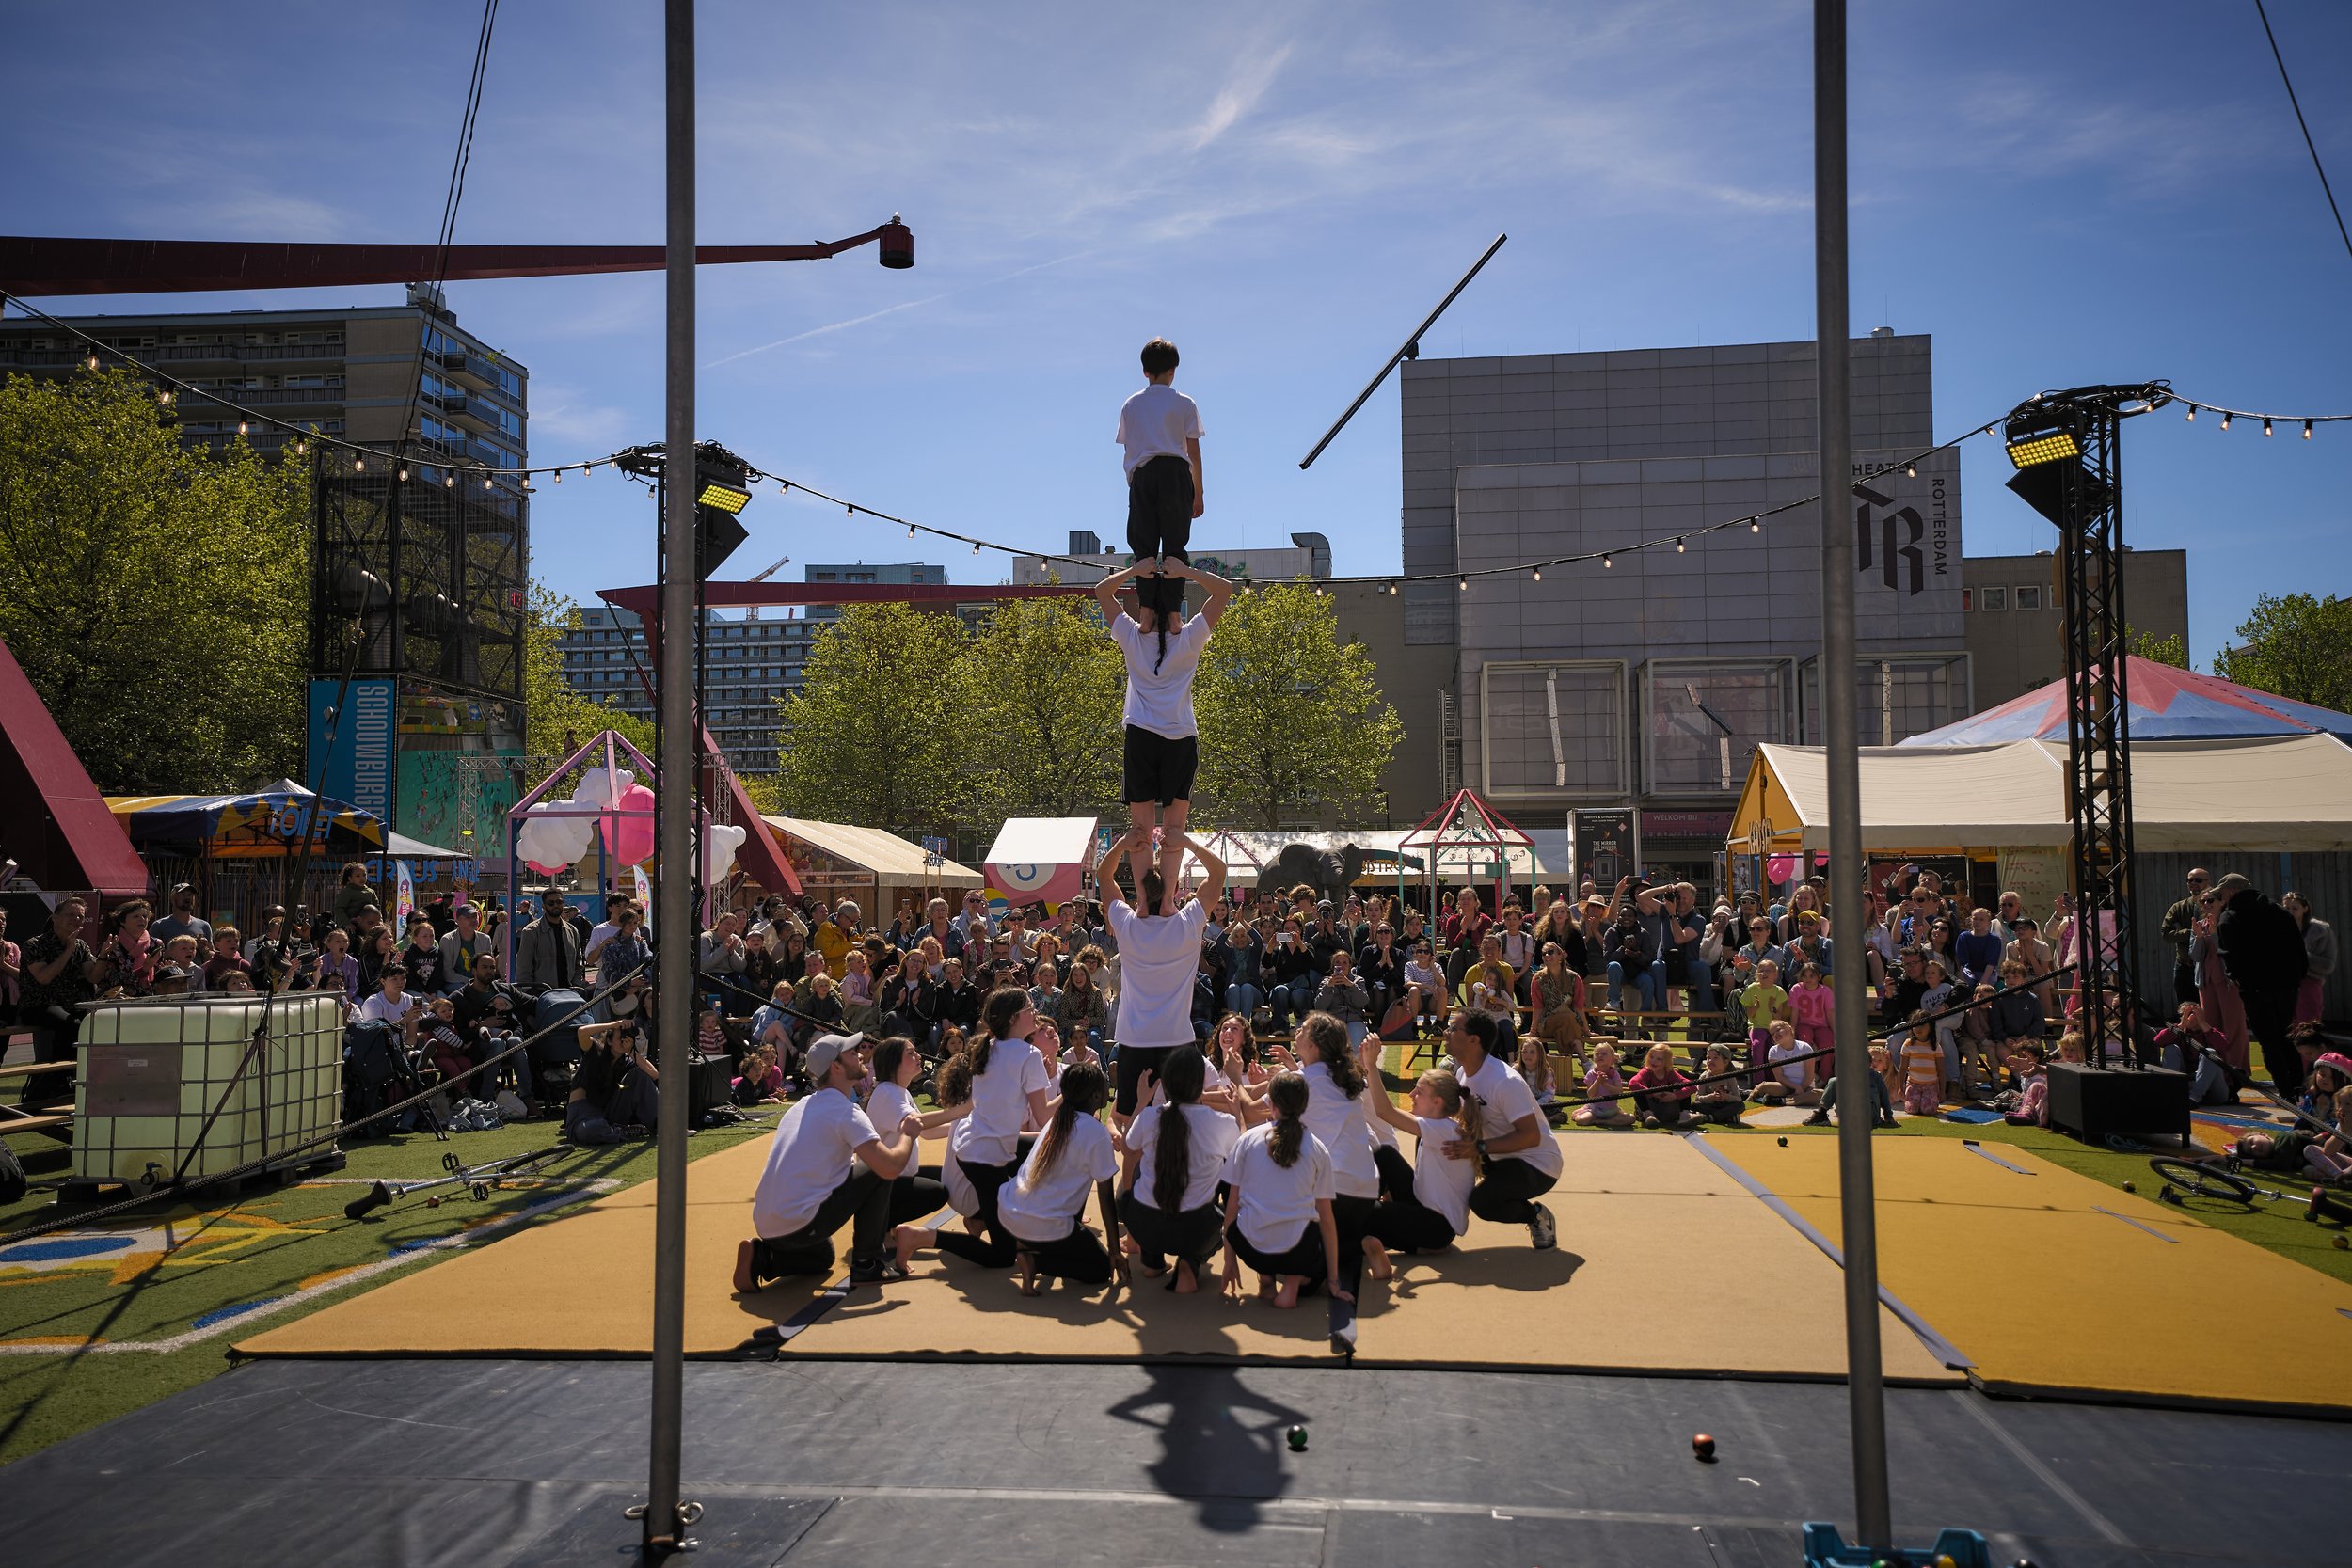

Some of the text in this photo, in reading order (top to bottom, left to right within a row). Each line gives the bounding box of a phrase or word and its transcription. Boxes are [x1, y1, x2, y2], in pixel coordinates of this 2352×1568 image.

[1851, 462, 1918, 477] HEATER
[1931, 478, 1947, 576] ROTTERDAM
[365, 859, 438, 883] CIRUS
[1798, 994, 1823, 1018] 91
